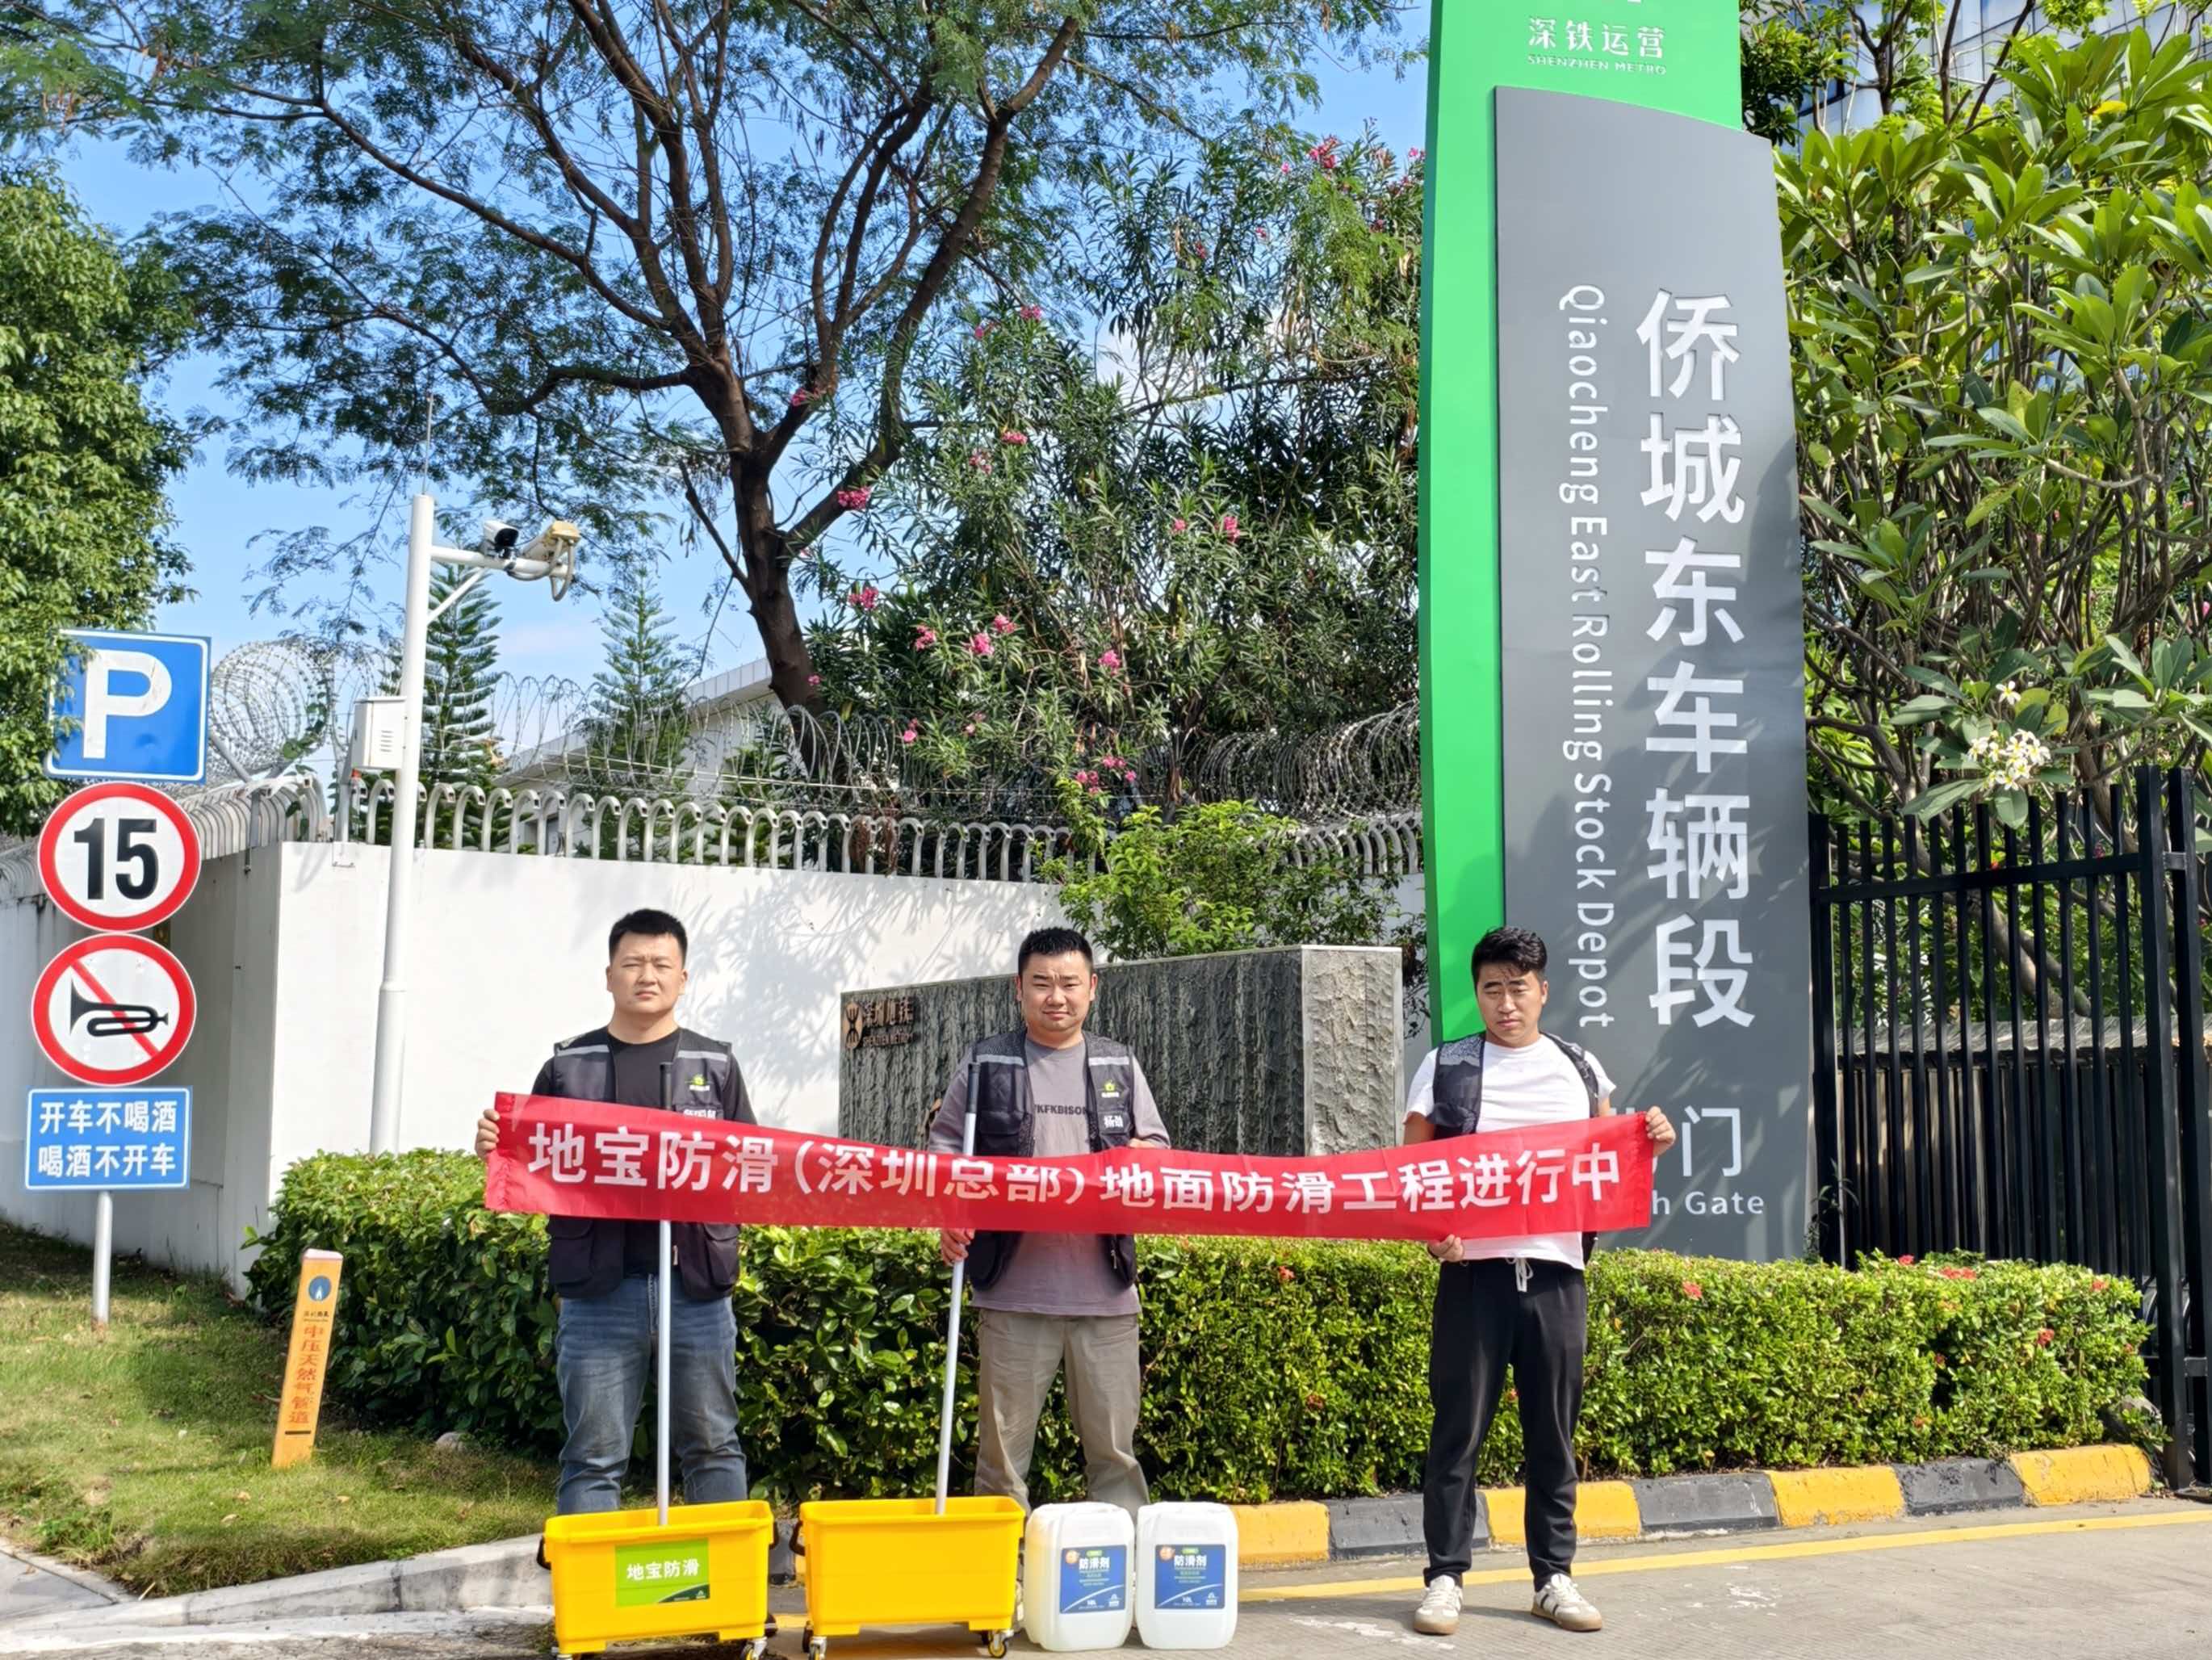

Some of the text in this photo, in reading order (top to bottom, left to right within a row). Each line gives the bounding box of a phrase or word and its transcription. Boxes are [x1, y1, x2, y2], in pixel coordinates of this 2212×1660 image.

[1528, 17, 1665, 58] 深铁运营
[1527, 54, 1667, 75] SHENZHEN METRO
[1559, 285, 1616, 1027] Qiaocheng East Rolling Stock Depot
[1636, 288, 1755, 1028] 侨城东车辆段
[83, 648, 172, 759] P
[74, 818, 159, 900] 15
[40, 1100, 178, 1134] 开车不喝酒
[38, 1142, 176, 1178] 喝酒不开车
[528, 1123, 1619, 1214] 地宝防滑（深圳总部）地面防滑工程进行中
[1685, 1191, 1764, 1214] Gate
[288, 1325, 324, 1423] 中压天然气管道
[626, 1558, 700, 1581] 地宝防滑
[1079, 1557, 1111, 1570] 防滑剂
[1174, 1554, 1207, 1567] 防滑剂
